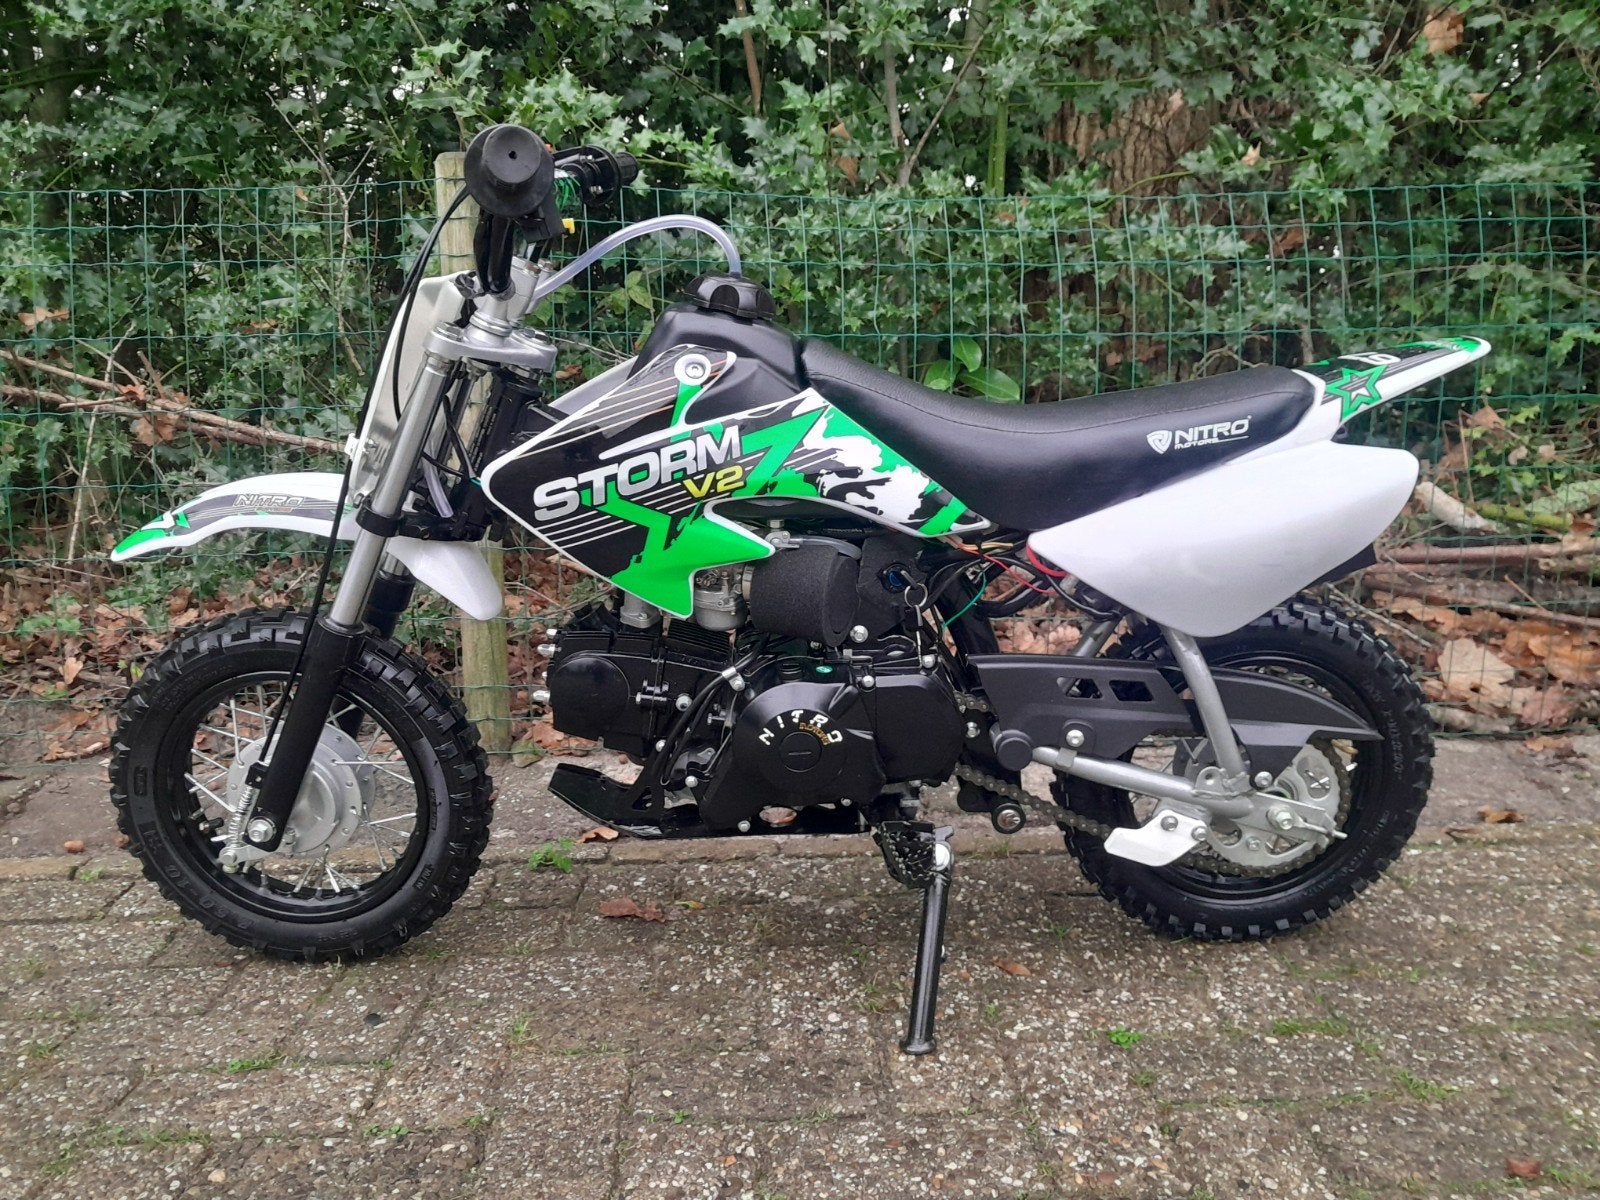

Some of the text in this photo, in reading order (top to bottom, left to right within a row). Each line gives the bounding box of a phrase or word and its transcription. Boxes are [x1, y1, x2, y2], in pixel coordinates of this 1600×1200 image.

[1174, 419, 1249, 444] NITRO
[1174, 437, 1219, 450] MOTORS
[533, 425, 741, 521] STORM
[683, 465, 744, 498] V2
[234, 494, 304, 507] NITRO
[759, 709, 843, 745] NITRO
